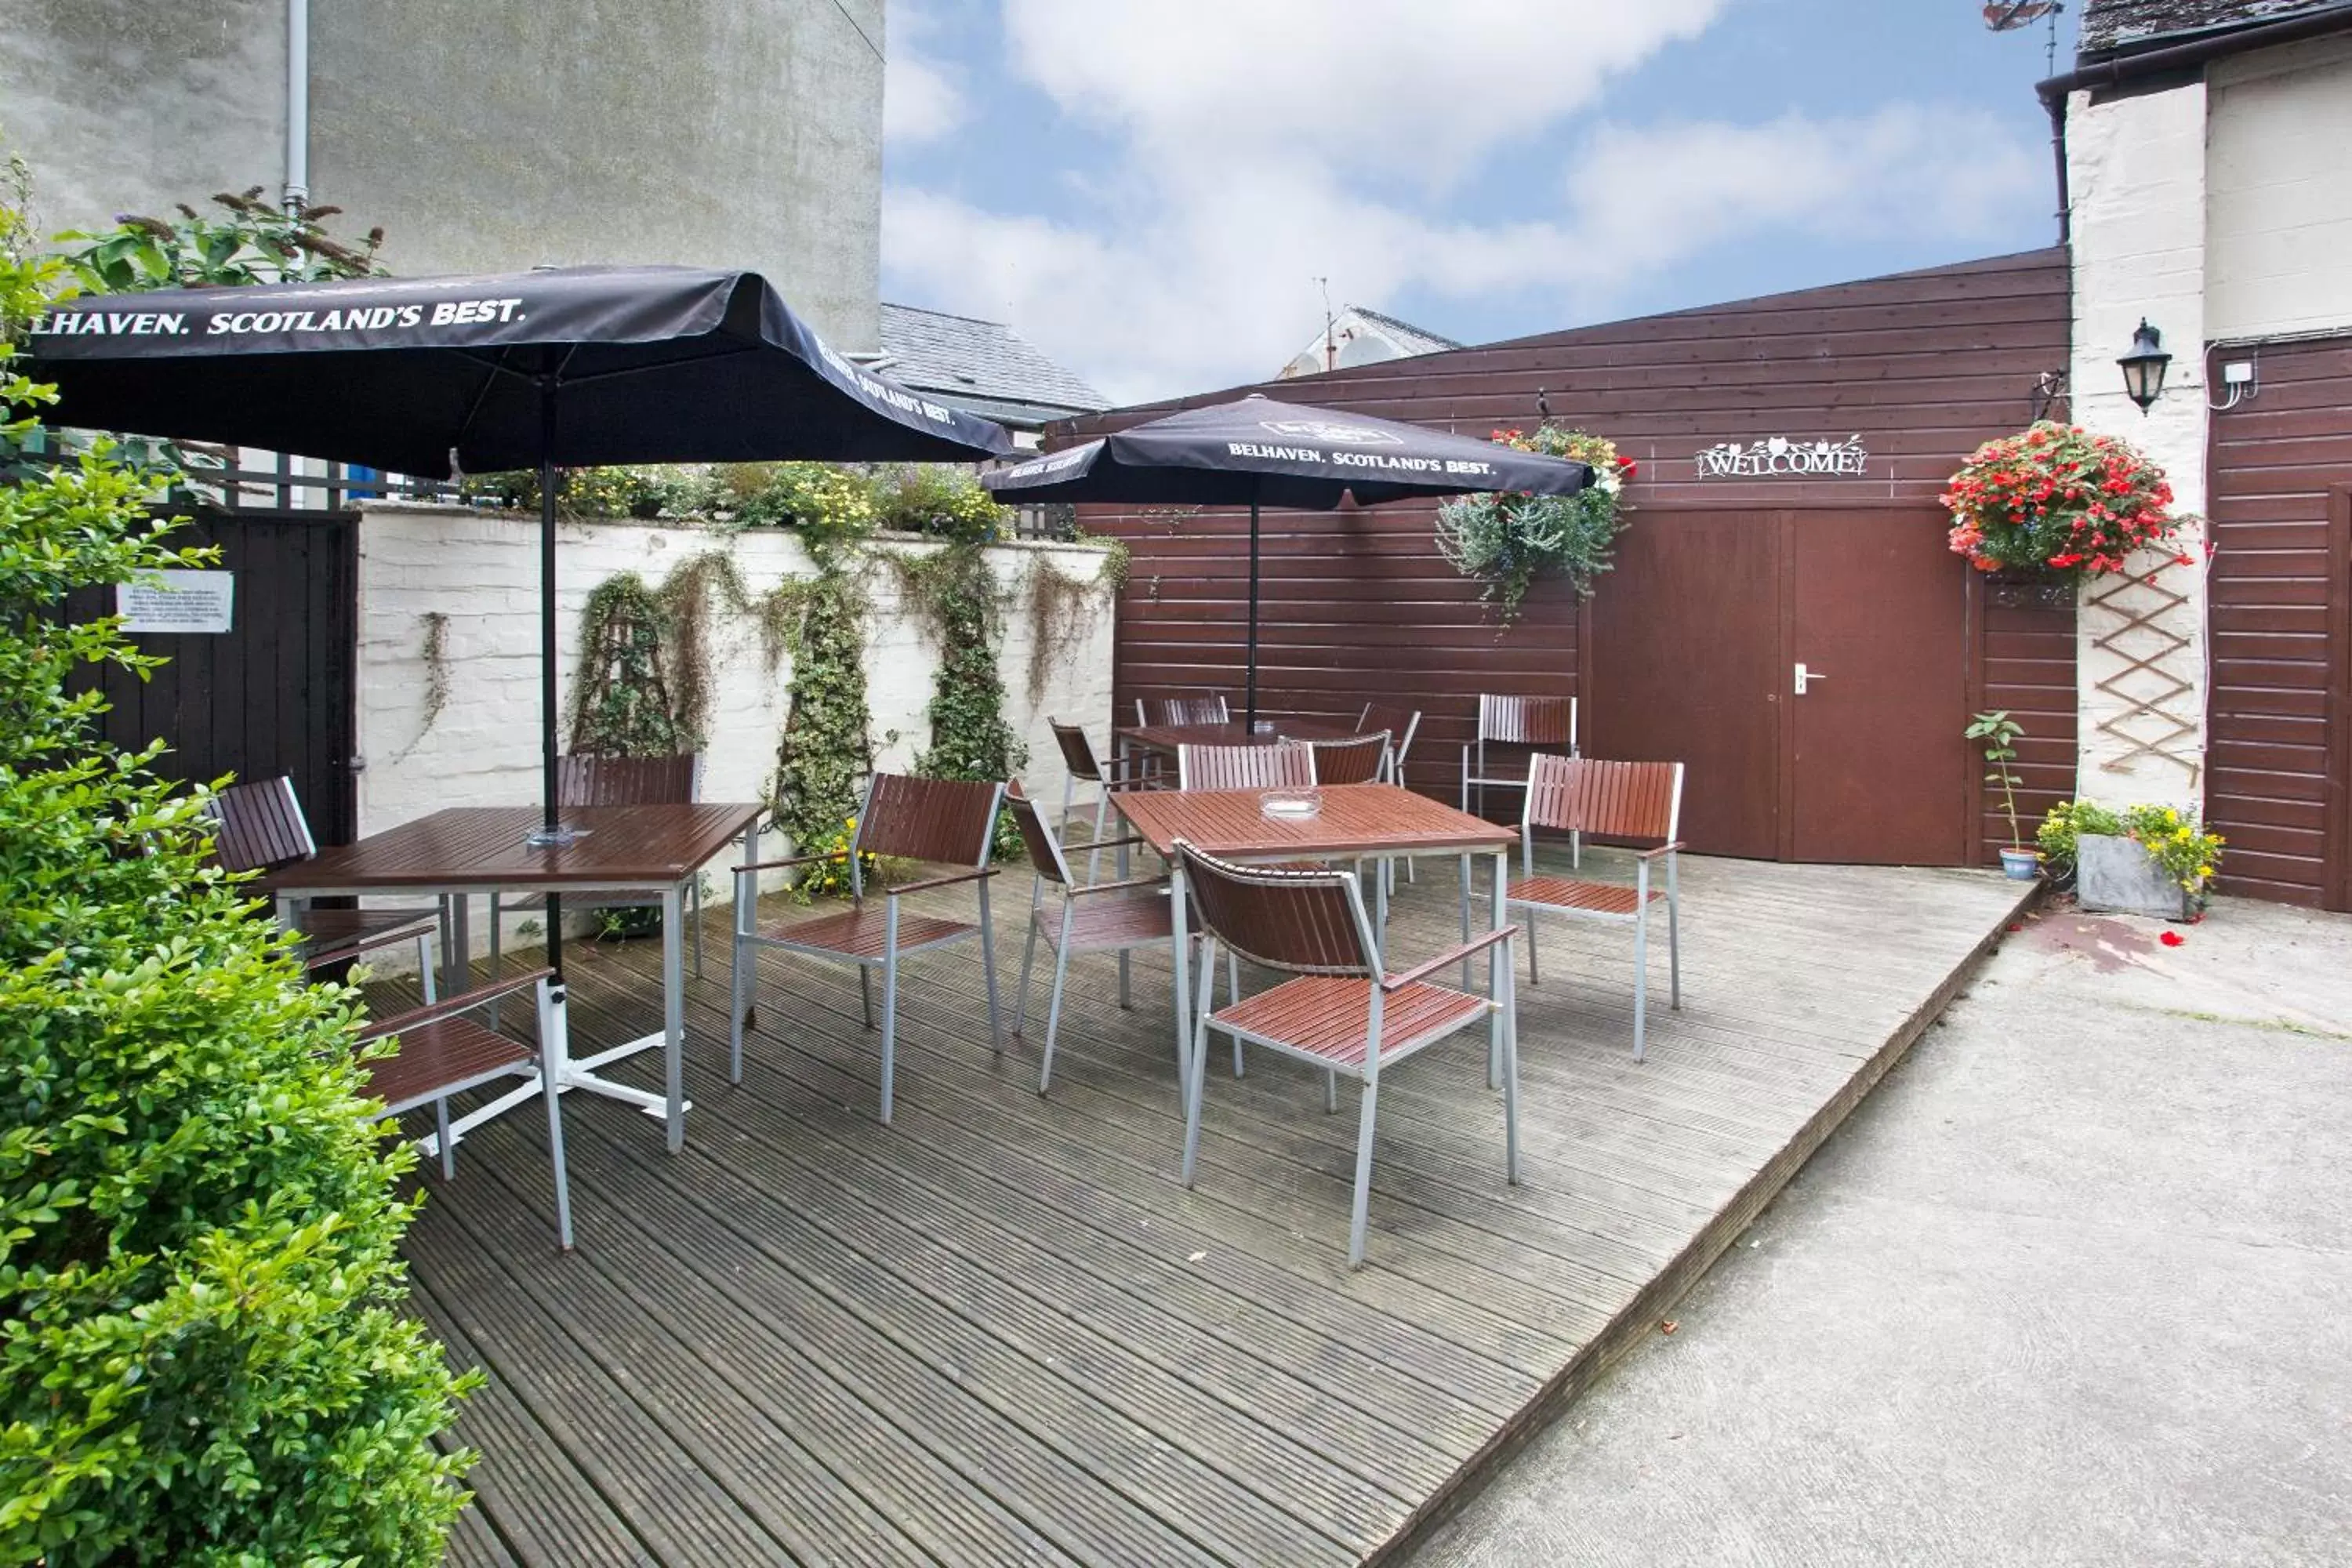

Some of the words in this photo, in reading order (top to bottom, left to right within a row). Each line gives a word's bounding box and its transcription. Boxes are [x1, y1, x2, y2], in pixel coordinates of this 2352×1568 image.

[30, 312, 191, 335] LHAVEN.
[206, 304, 422, 334] SCOTLAND'S
[430, 298, 527, 326] BEST.
[1229, 442, 1326, 463] BELHAVEN.
[1333, 452, 1441, 473] SCOTLAND'S
[1446, 461, 1498, 476] BEST.
[1704, 452, 1857, 474] WELCOME
